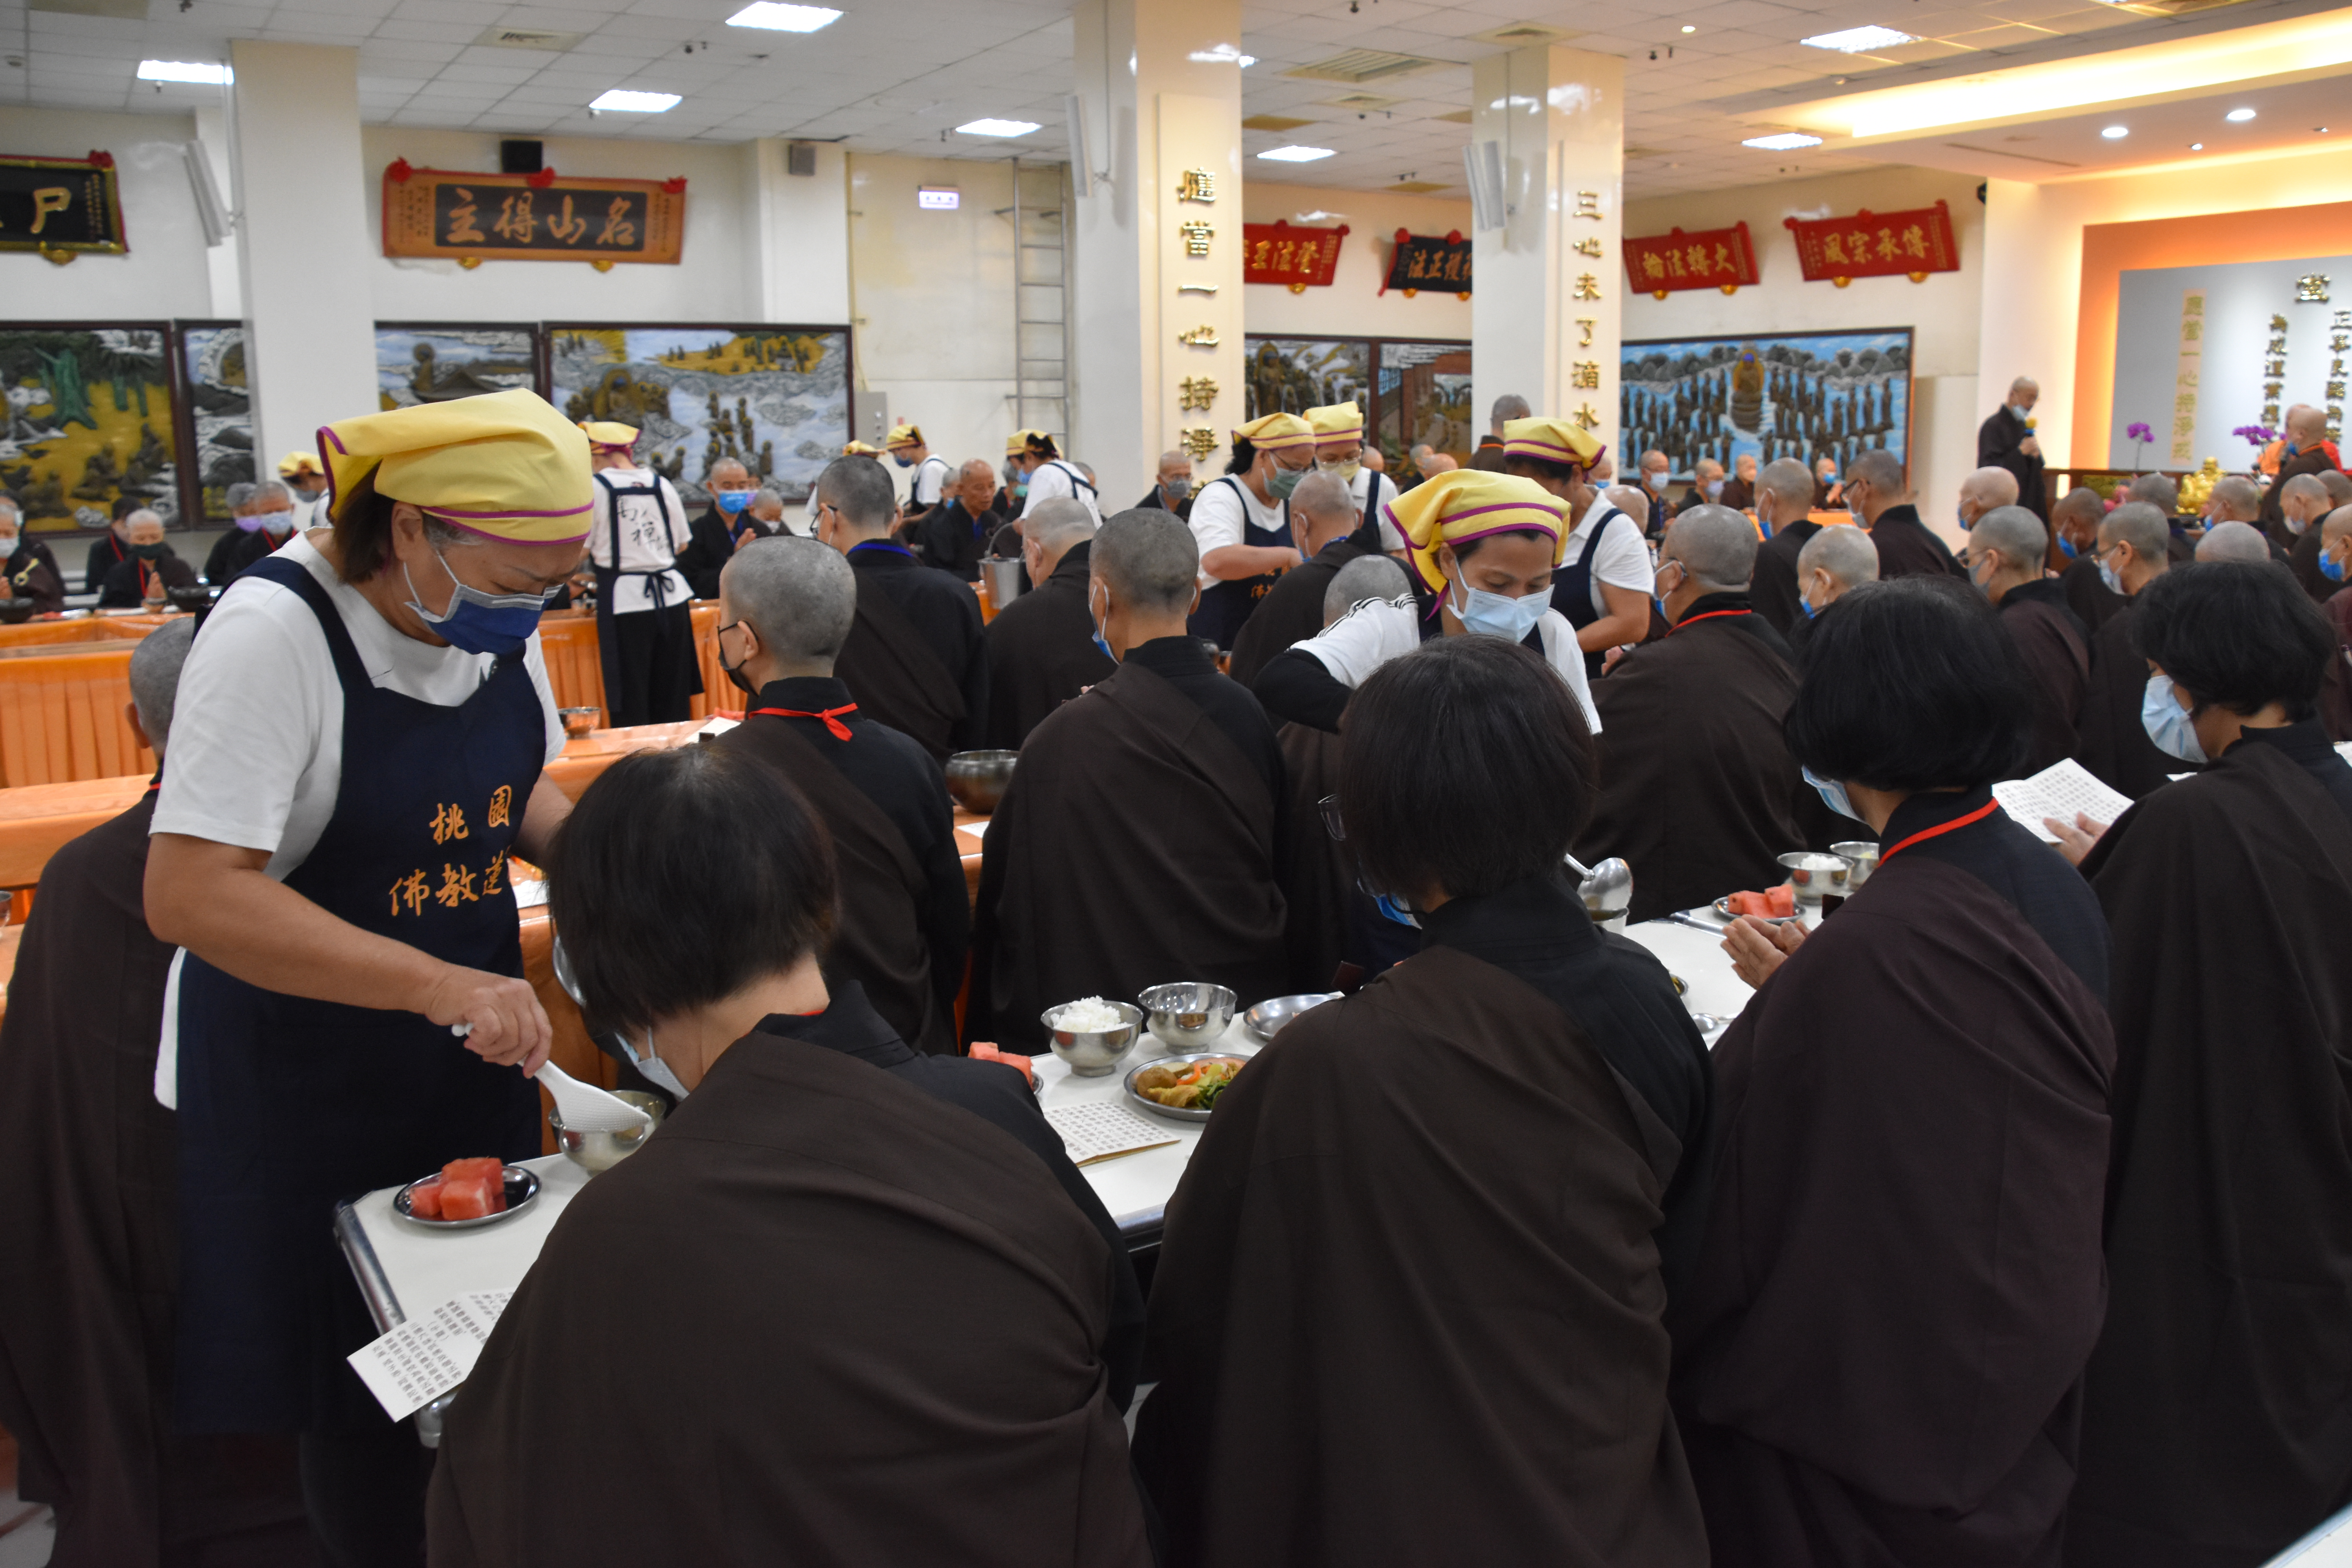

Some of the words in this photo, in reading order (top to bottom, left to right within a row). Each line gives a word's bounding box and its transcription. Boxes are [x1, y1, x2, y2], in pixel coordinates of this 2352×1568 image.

[446, 188, 636, 246] 名山得主
[1571, 190, 1604, 430] 三心未了滴水
[429, 785, 512, 845] 桃園
